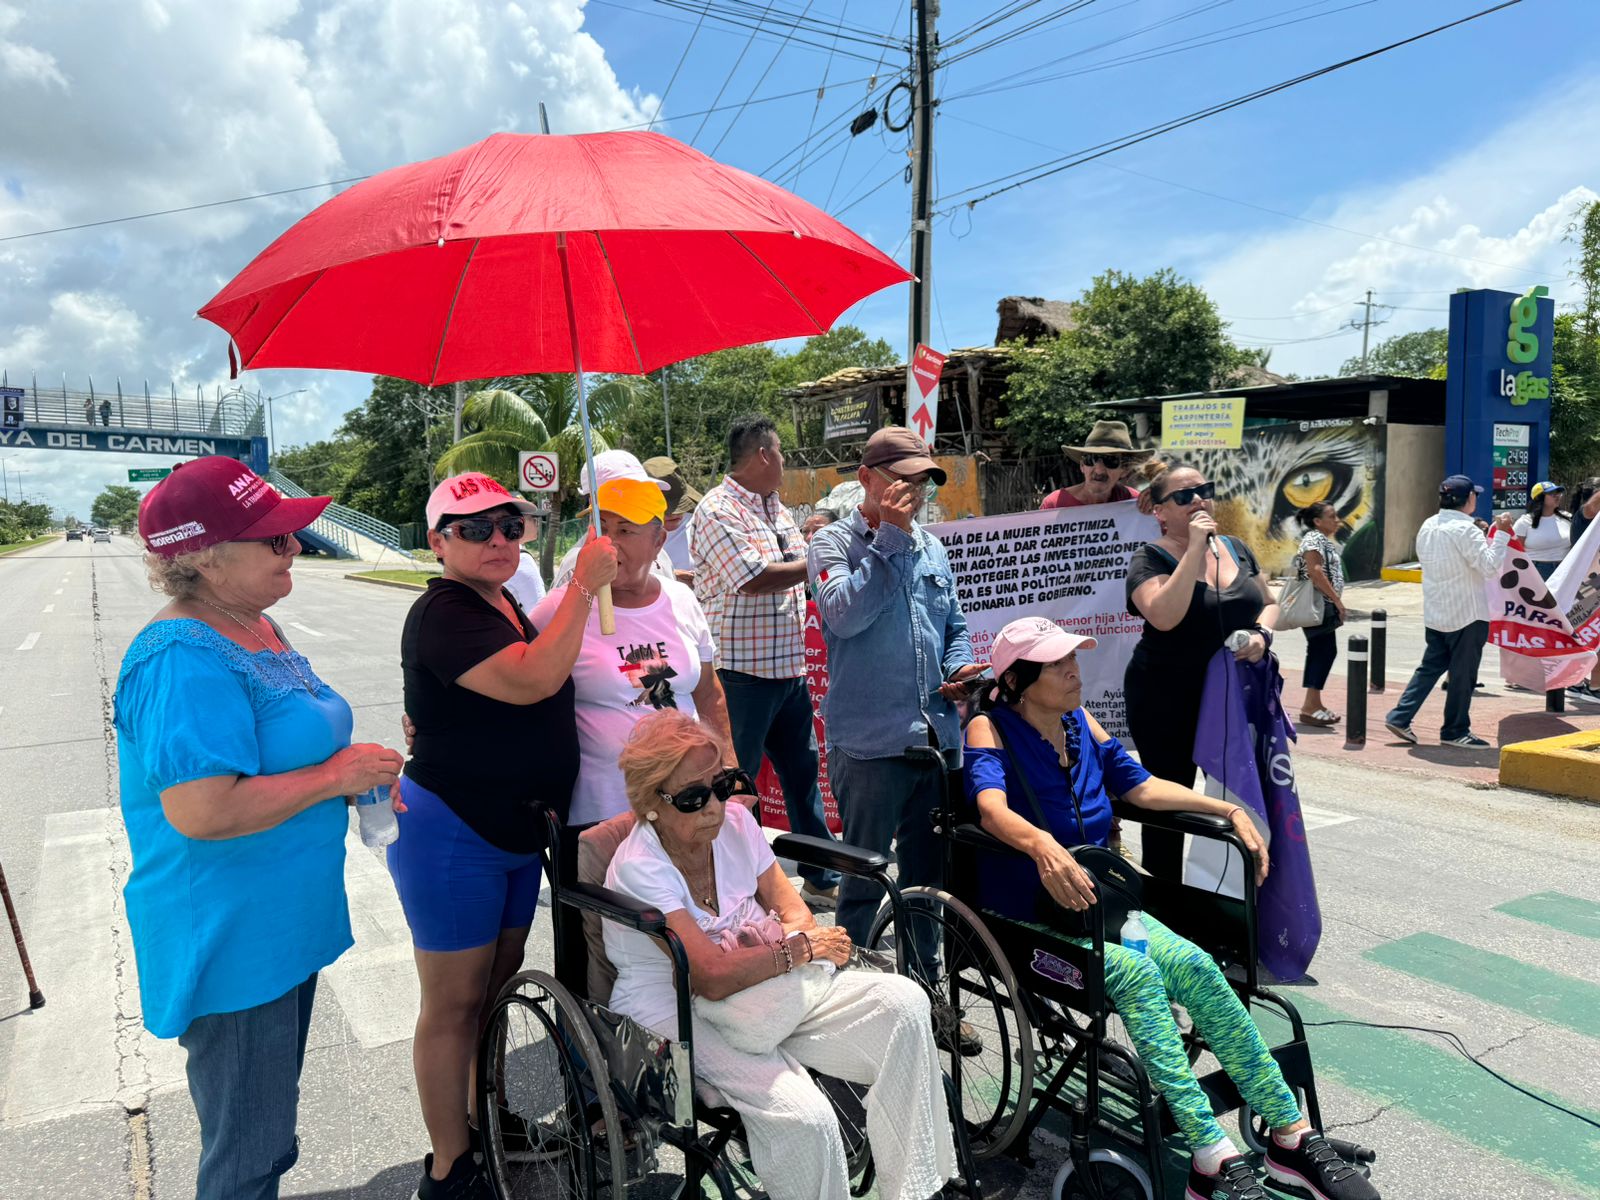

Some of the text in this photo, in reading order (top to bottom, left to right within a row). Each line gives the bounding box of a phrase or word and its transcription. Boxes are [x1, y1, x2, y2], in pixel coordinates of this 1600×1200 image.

[1173, 403, 1218, 411] TRABAJOS
[1173, 413, 1231, 421] CARPINTERÍA
[47, 432, 97, 450] DEL
[107, 435, 216, 455] CARMEN
[228, 473, 255, 497] ANA
[450, 478, 480, 502] LAS
[149, 528, 185, 548] morena
[966, 532, 982, 544] DE
[986, 531, 1000, 542] LA
[1003, 526, 1040, 540] MUJER
[1044, 518, 1116, 535] REVICTIMIZA
[966, 545, 994, 558] HIJA,
[996, 543, 1010, 555] AL
[1014, 540, 1037, 553] DAR
[1040, 532, 1109, 549] CARPETAZO
[1112, 531, 1120, 541] A
[950, 561, 968, 574] SIN
[970, 556, 1017, 571] AGOTAR
[1020, 552, 1041, 565] LAS
[956, 556, 1129, 587] PROTEGER A PAOLA MORENO.
[976, 586, 992, 598] ES
[995, 582, 1018, 595] UNA
[1021, 574, 1071, 591] POLÍTICA
[1018, 593, 1034, 605] DE
[1037, 585, 1096, 602] GOBIERNO.
[1055, 616, 1092, 627] menor
[1095, 612, 1115, 625] hija
[1503, 601, 1563, 629] PARA
[616, 641, 669, 661] TIME
